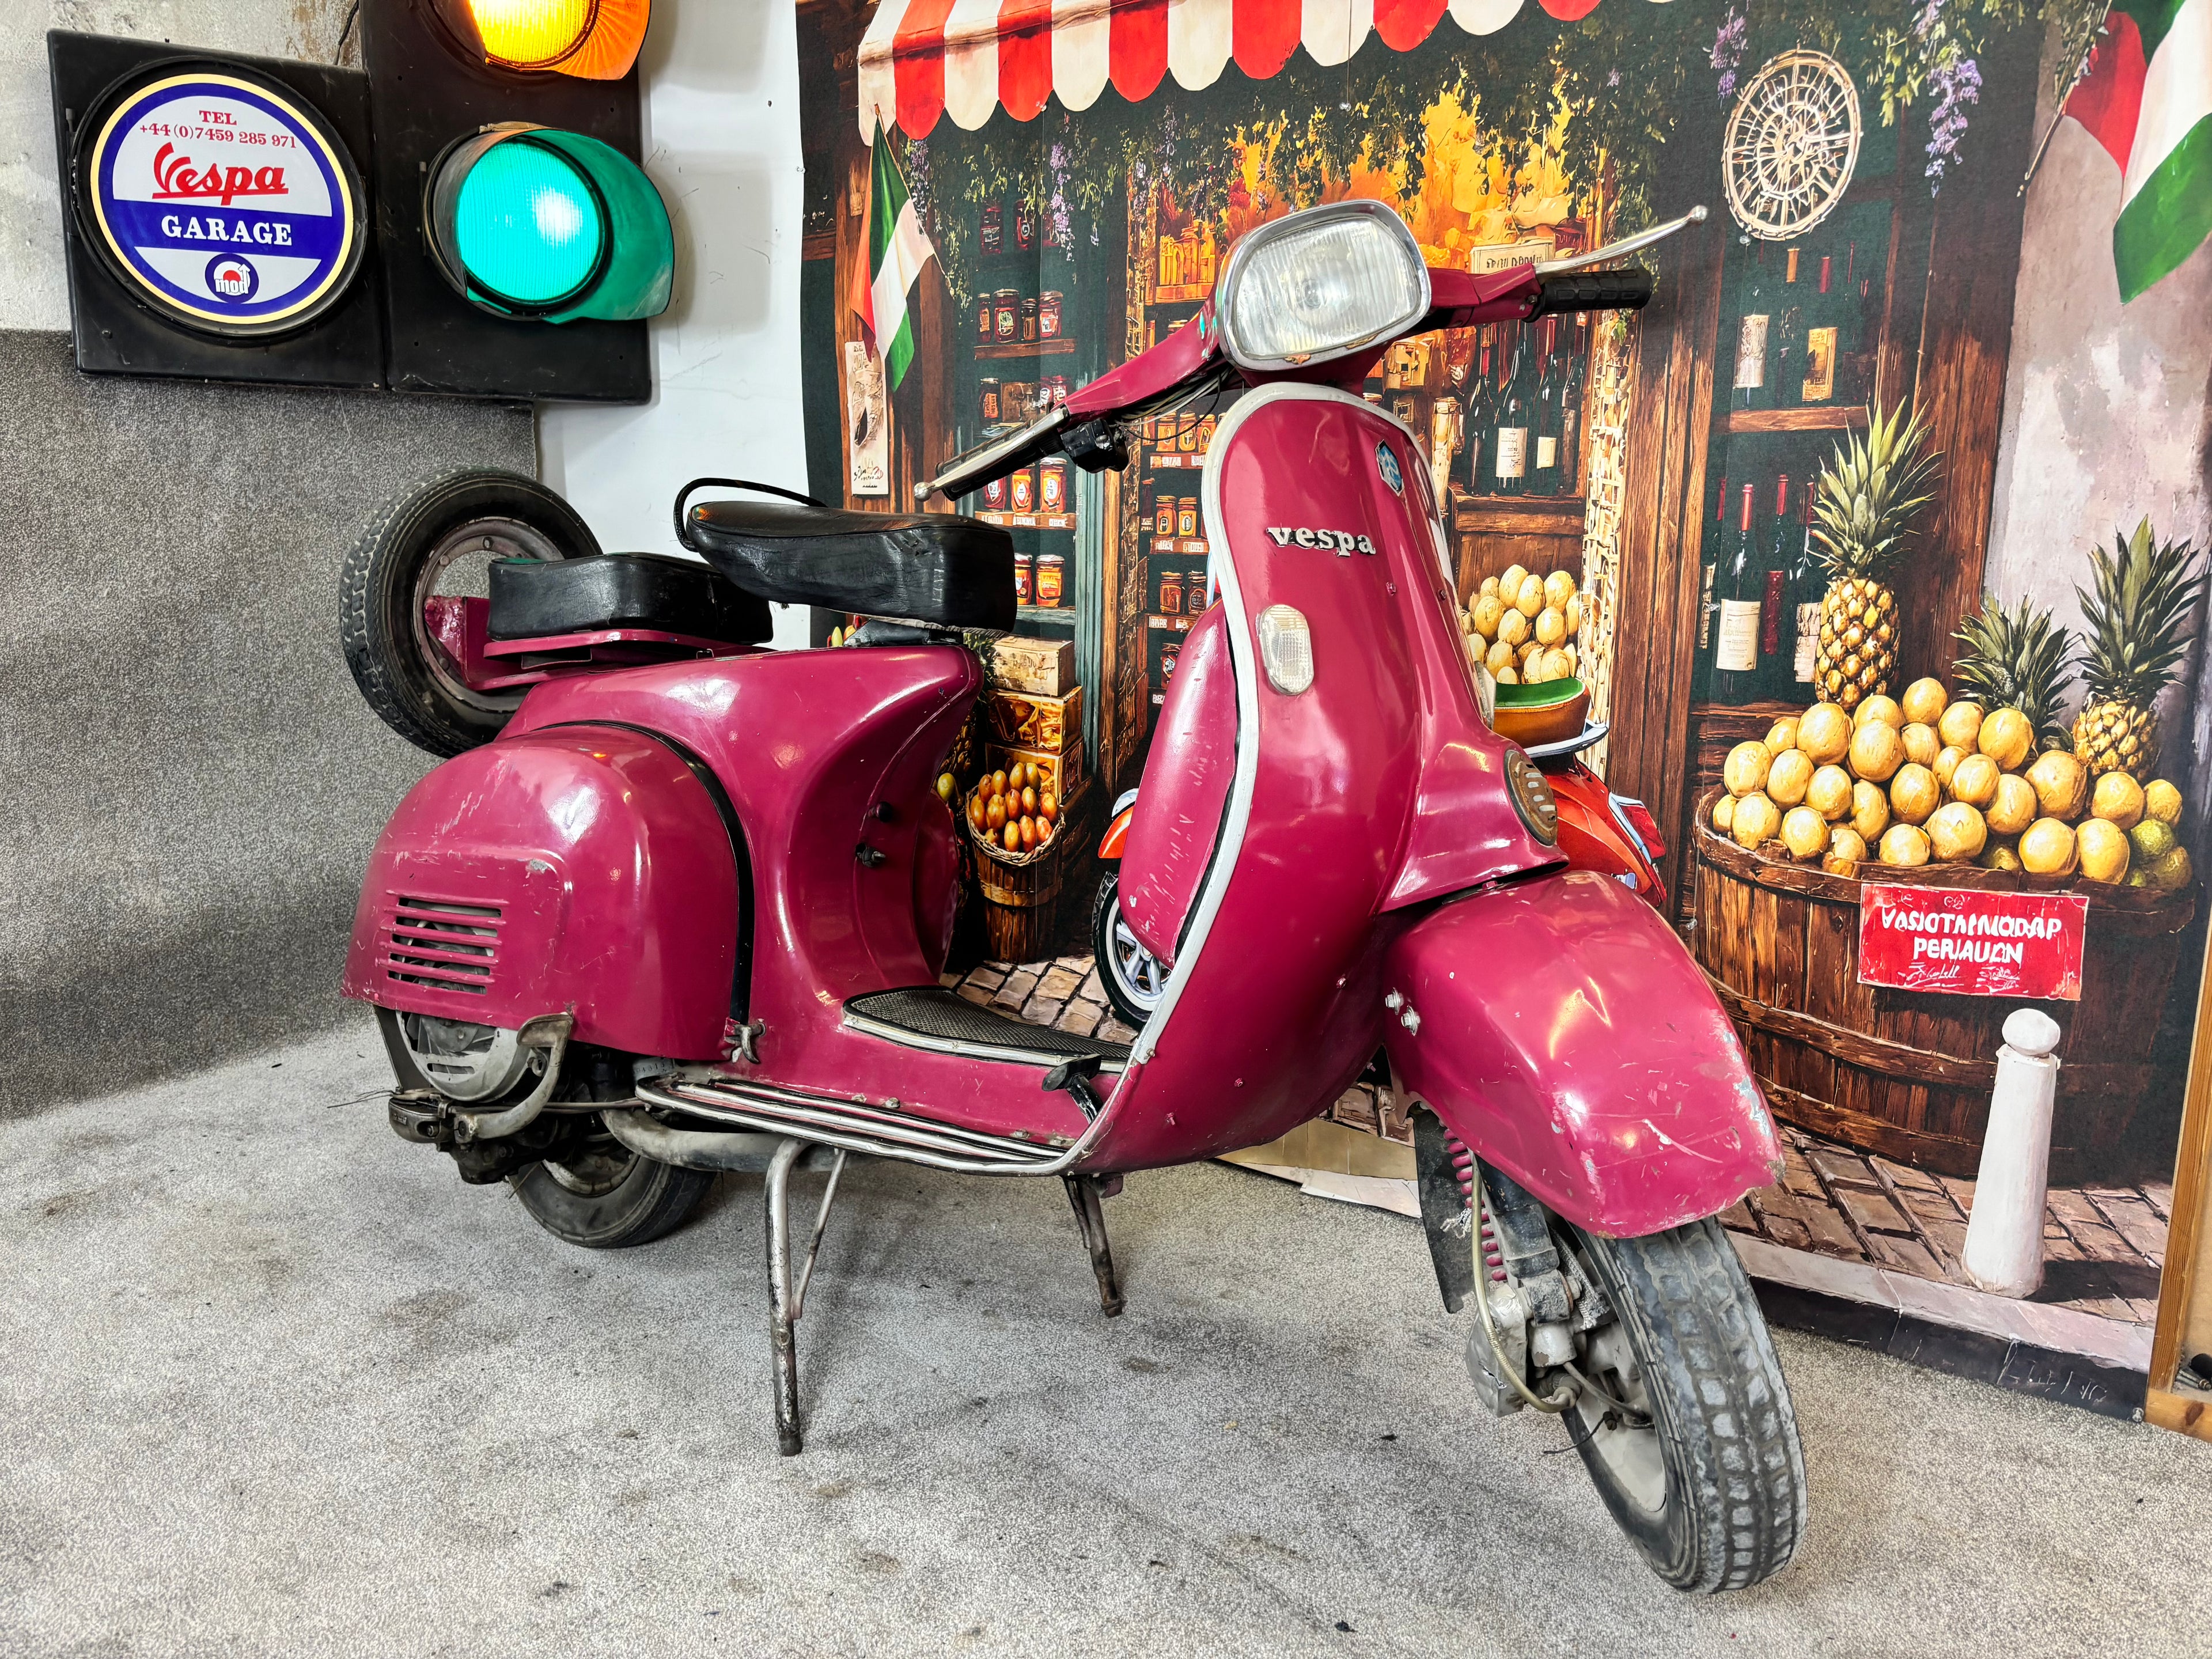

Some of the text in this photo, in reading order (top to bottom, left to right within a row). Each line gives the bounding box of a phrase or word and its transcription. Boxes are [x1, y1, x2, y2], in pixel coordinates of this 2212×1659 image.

[199, 110, 237, 126] TEL
[239, 131, 267, 145] 285
[271, 134, 296, 148] 971
[153, 142, 288, 206] Vespa
[161, 215, 292, 245] GARAGE
[1266, 527, 1376, 557] vespa
